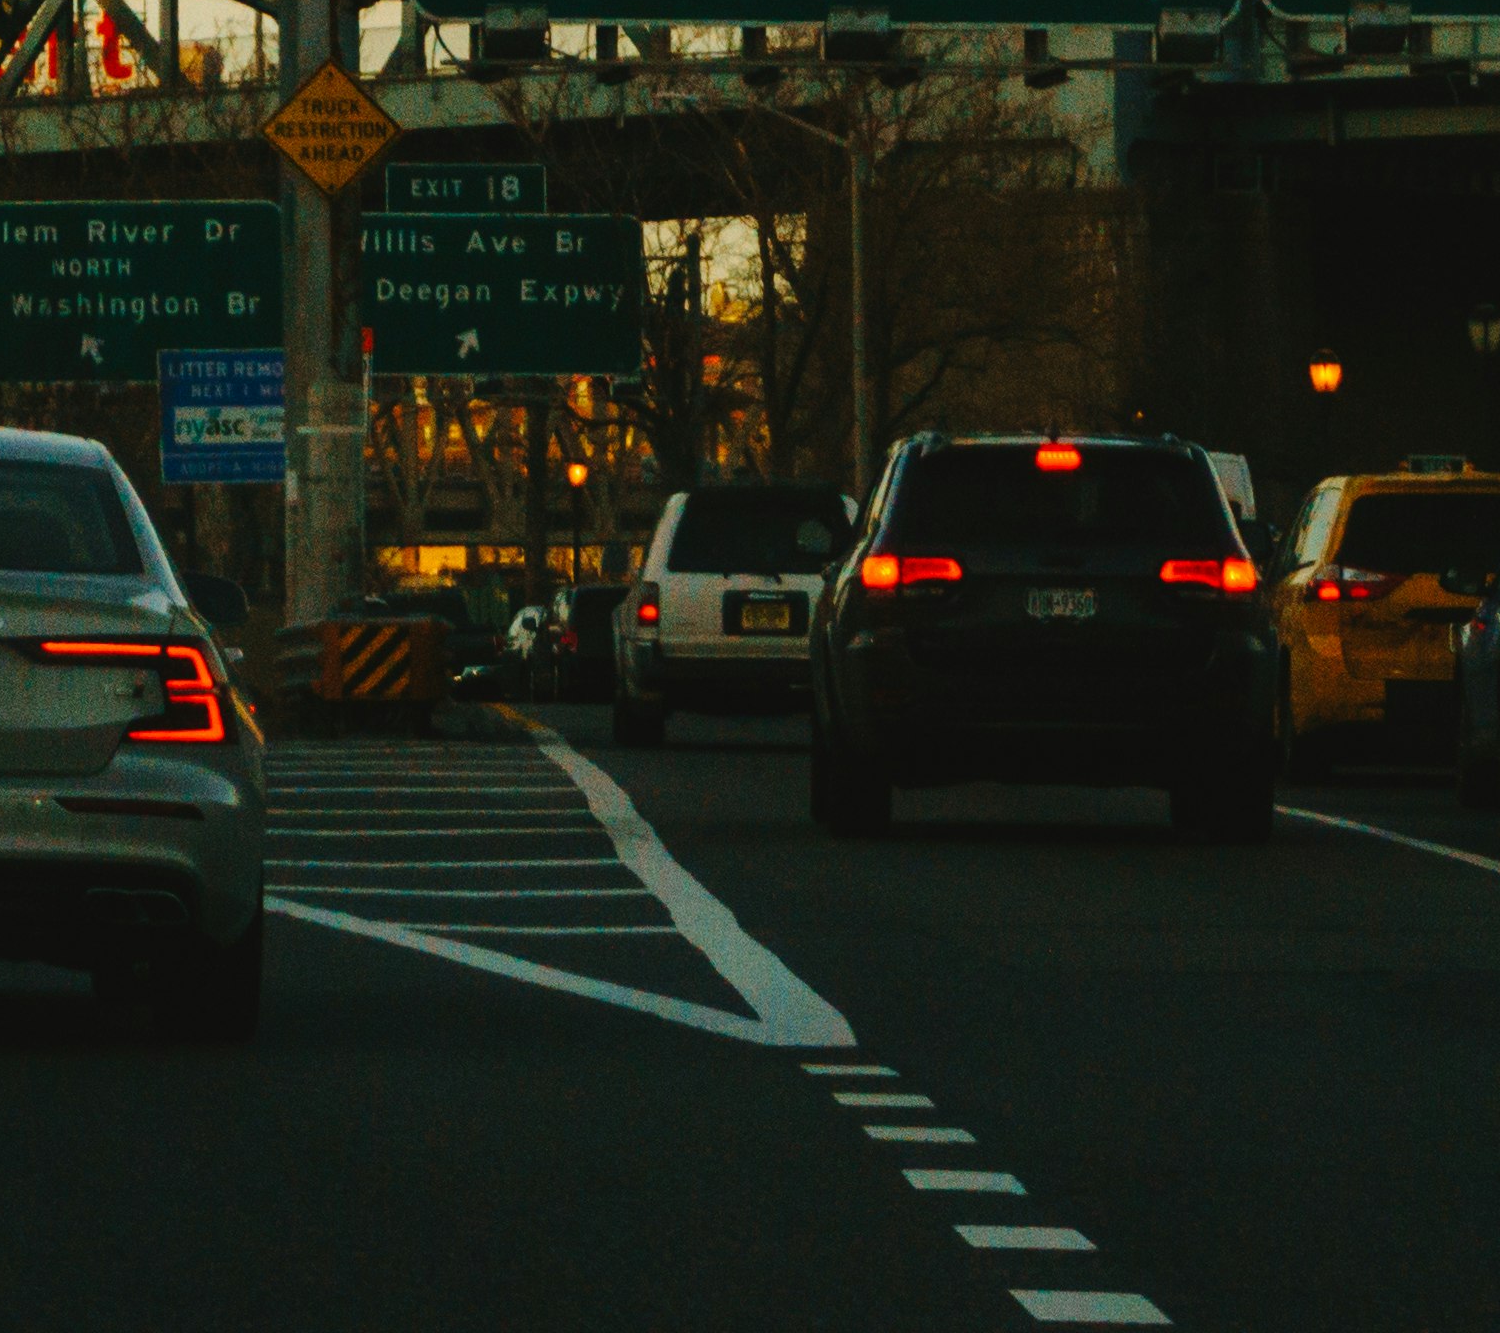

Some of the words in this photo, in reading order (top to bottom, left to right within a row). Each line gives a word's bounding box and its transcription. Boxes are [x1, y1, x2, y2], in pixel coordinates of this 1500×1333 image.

[300, 99, 360, 116] TRUCK
[274, 121, 387, 138] RESTRICTION
[300, 144, 364, 162] AHEAD
[411, 179, 462, 197] EXIT
[489, 175, 520, 201] 18
[87, 219, 173, 243] River
[204, 218, 239, 242] Dr
[360, 230, 435, 253] illis
[466, 230, 525, 253] Ave
[556, 230, 583, 254] Br
[53, 258, 131, 277] NORTH
[376, 277, 491, 310] Deegan
[520, 278, 623, 311] Expwy
[12, 293, 199, 323] Washington
[227, 291, 260, 315] Br
[168, 361, 228, 378] LITTER
[191, 383, 234, 398] NEXT
